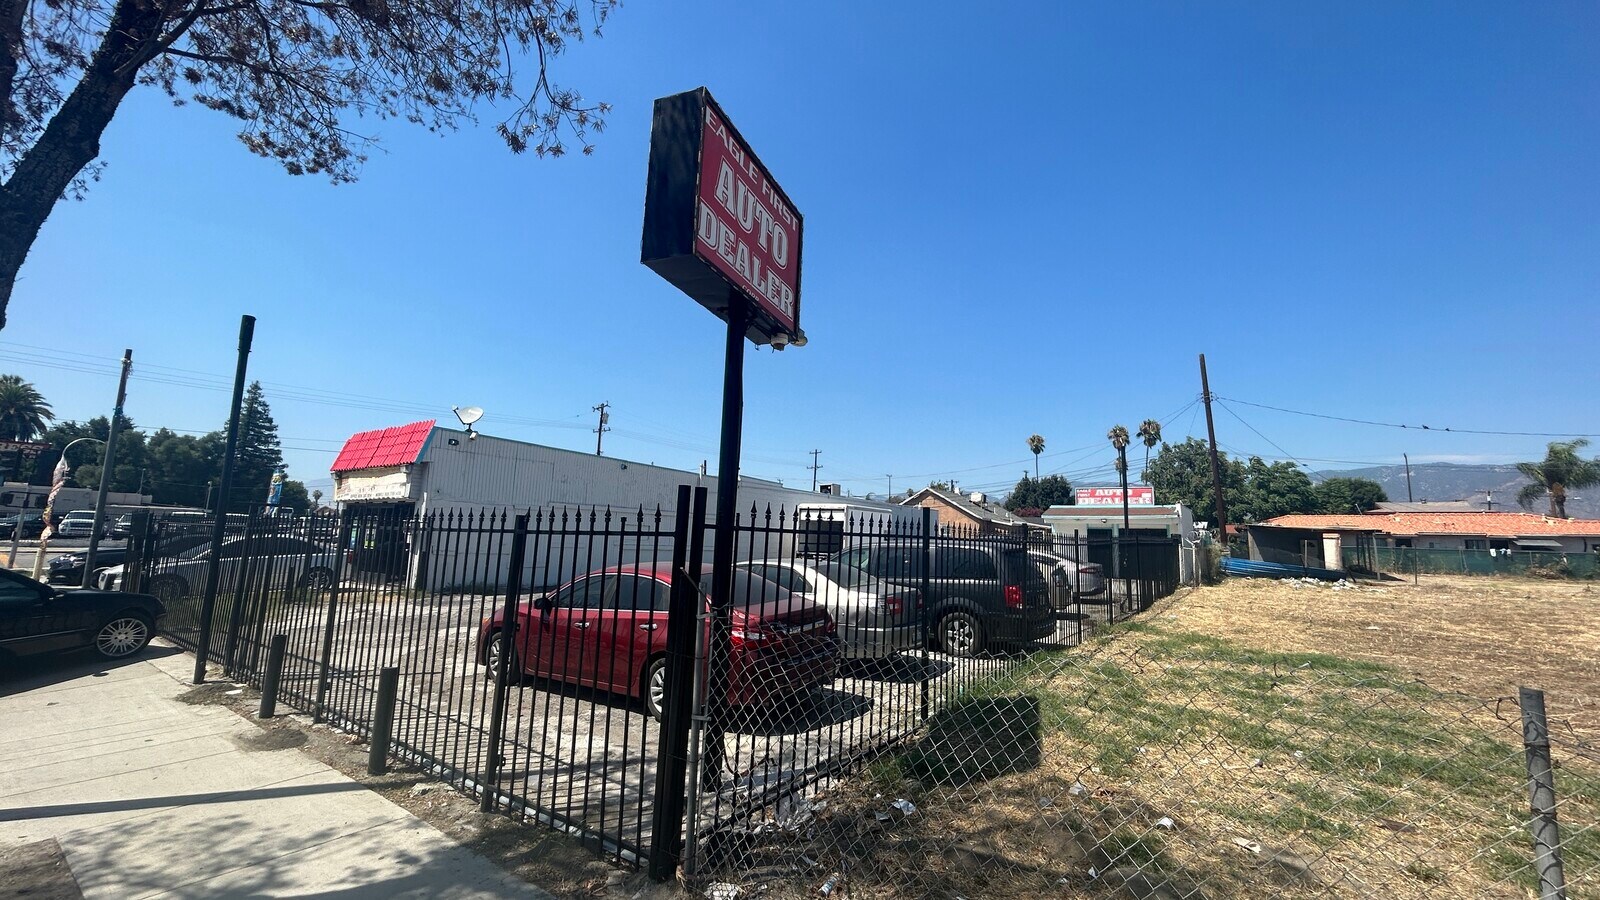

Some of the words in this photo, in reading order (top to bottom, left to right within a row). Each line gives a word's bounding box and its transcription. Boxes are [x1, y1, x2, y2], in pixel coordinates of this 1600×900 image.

[705, 105, 758, 184] EAGLE
[761, 183, 799, 231] FIRST
[714, 155, 788, 270] AUTO
[697, 201, 794, 321] DEALER
[1077, 497, 1152, 505] DEALER
